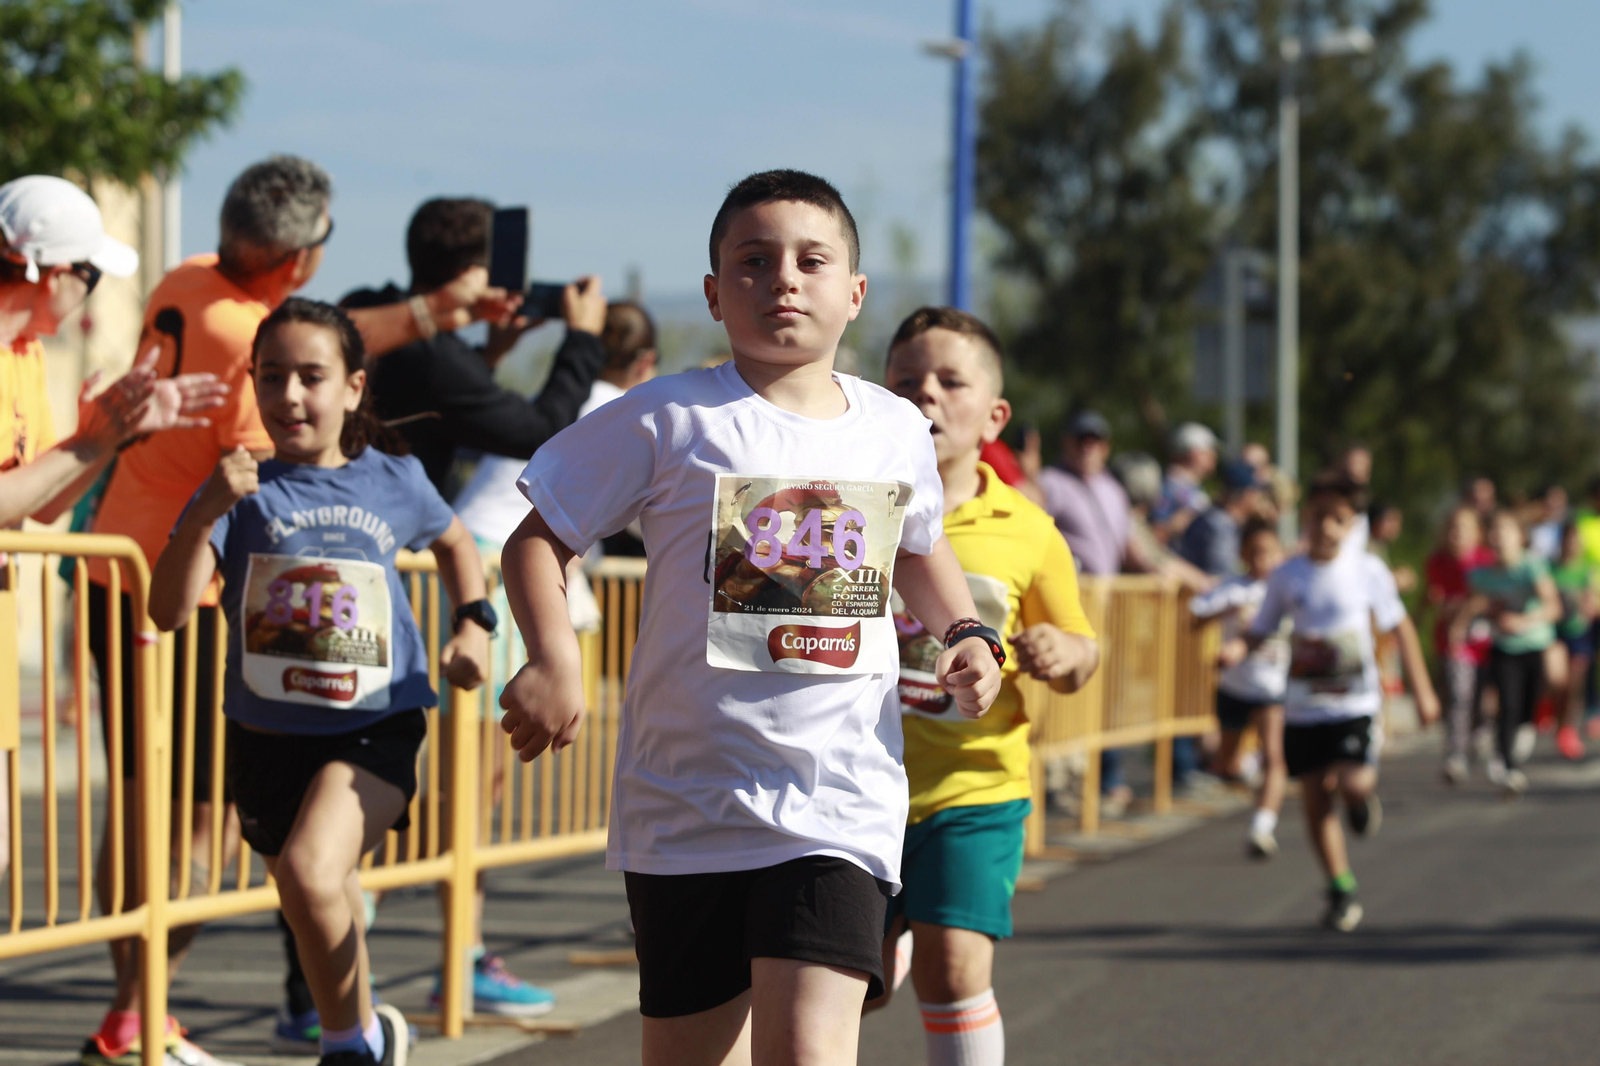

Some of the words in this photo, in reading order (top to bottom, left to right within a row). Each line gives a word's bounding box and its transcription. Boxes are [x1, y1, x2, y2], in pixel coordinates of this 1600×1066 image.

[814, 483, 845, 491] SEGURA
[847, 484, 873, 492] GARCÍA
[265, 505, 395, 555] PLAYGROUND
[745, 507, 867, 570] 846
[832, 567, 882, 584] XIII
[832, 584, 880, 592] CARRERA
[832, 592, 879, 601] POPULAR
[267, 580, 358, 629] 816
[791, 606, 812, 614] 2024
[831, 607, 848, 615] DEL
